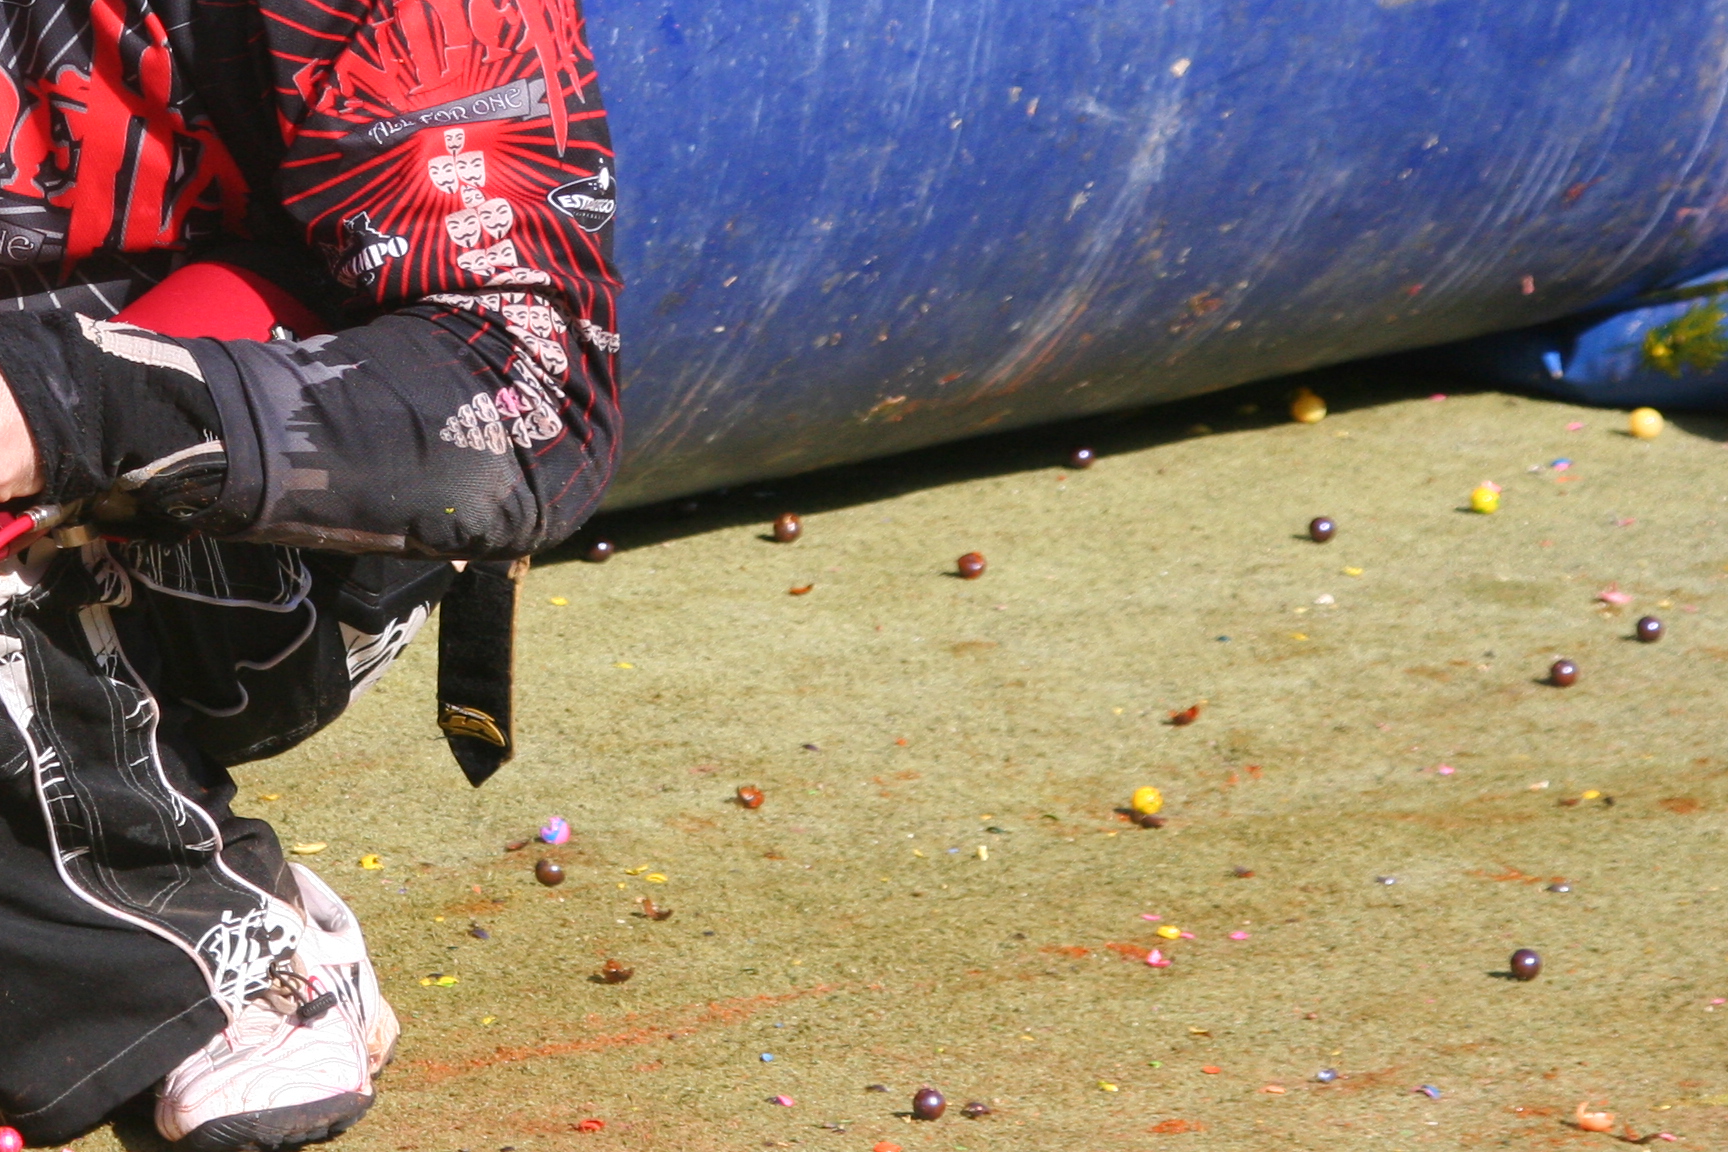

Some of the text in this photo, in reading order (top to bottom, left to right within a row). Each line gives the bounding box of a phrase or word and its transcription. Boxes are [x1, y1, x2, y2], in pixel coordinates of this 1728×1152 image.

[368, 88, 523, 146] ALL FOR ONE
